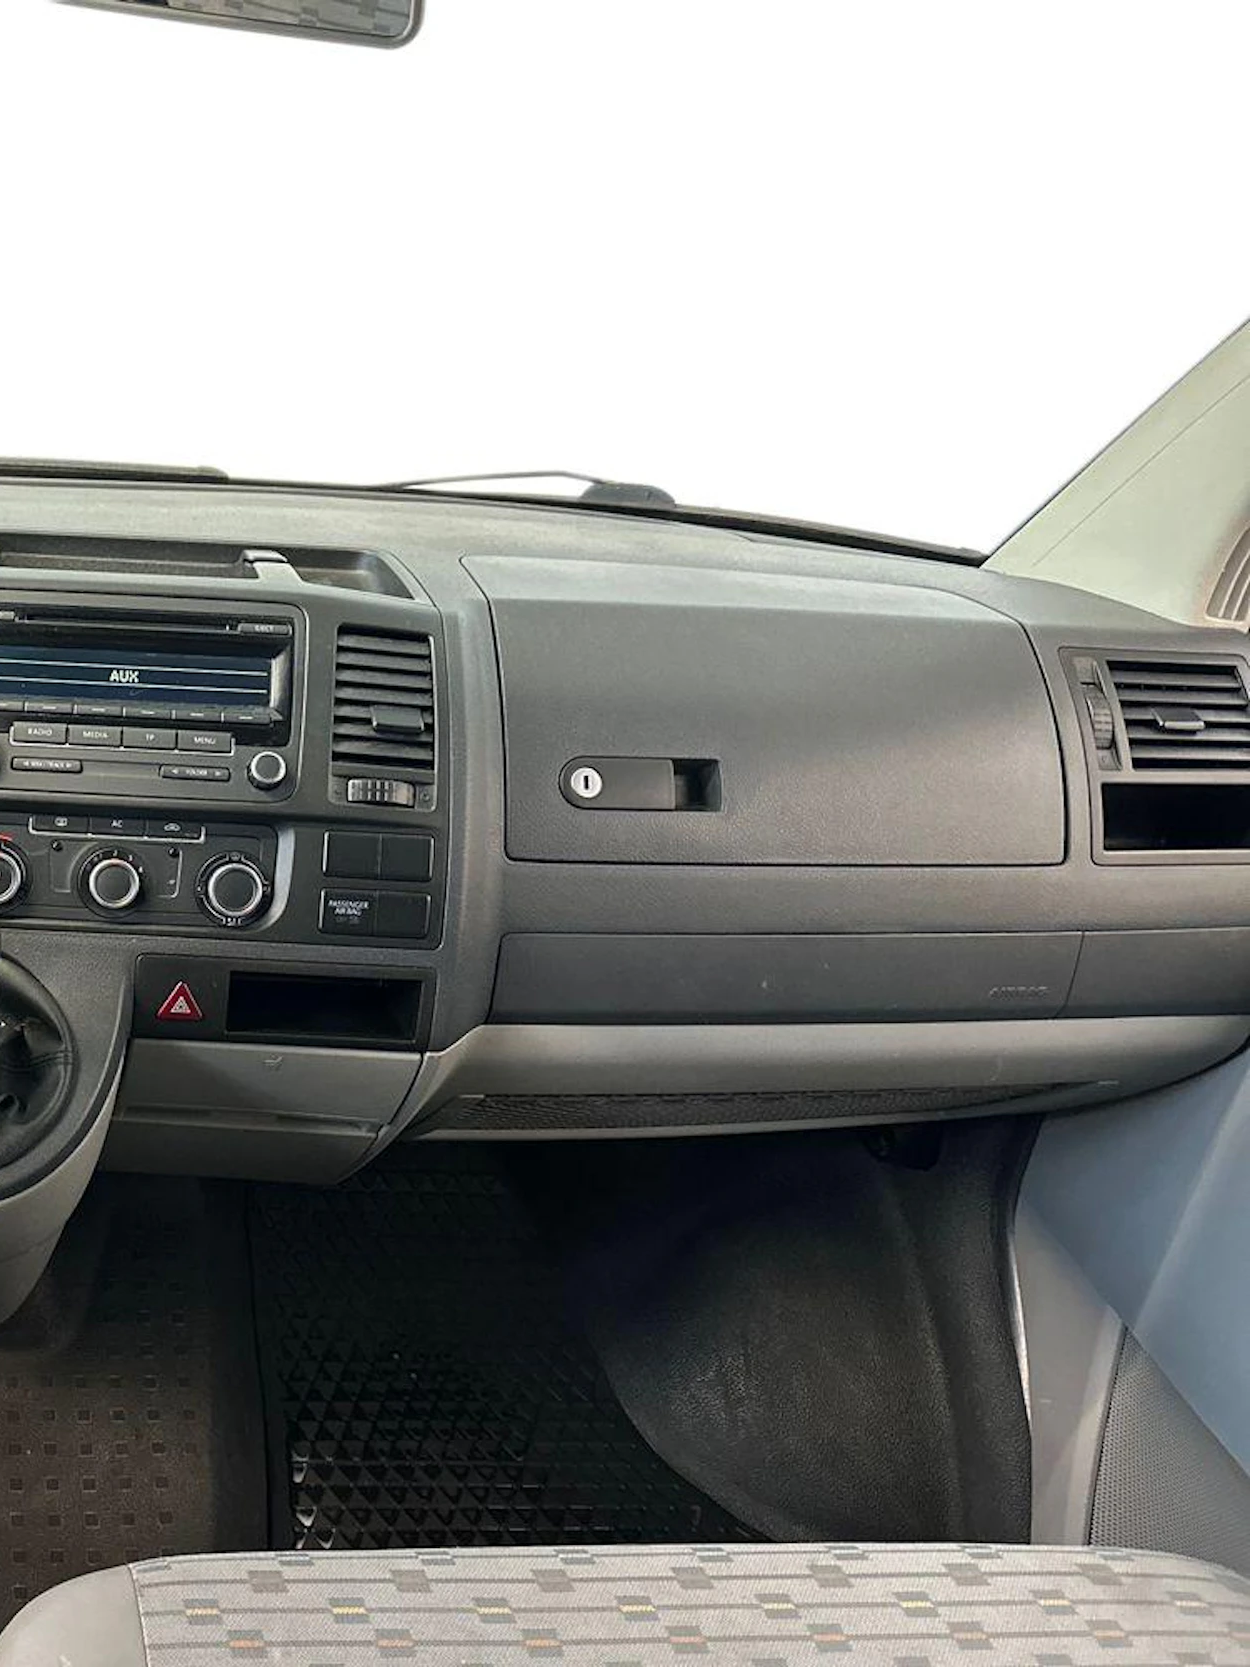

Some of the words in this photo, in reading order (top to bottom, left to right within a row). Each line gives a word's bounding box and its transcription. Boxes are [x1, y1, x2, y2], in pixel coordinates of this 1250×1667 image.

[109, 669, 140, 683] AUX
[27, 727, 53, 736] RADIO
[82, 730, 109, 739] MEDIA
[194, 736, 217, 745] MENU
[110, 819, 123, 828] AC
